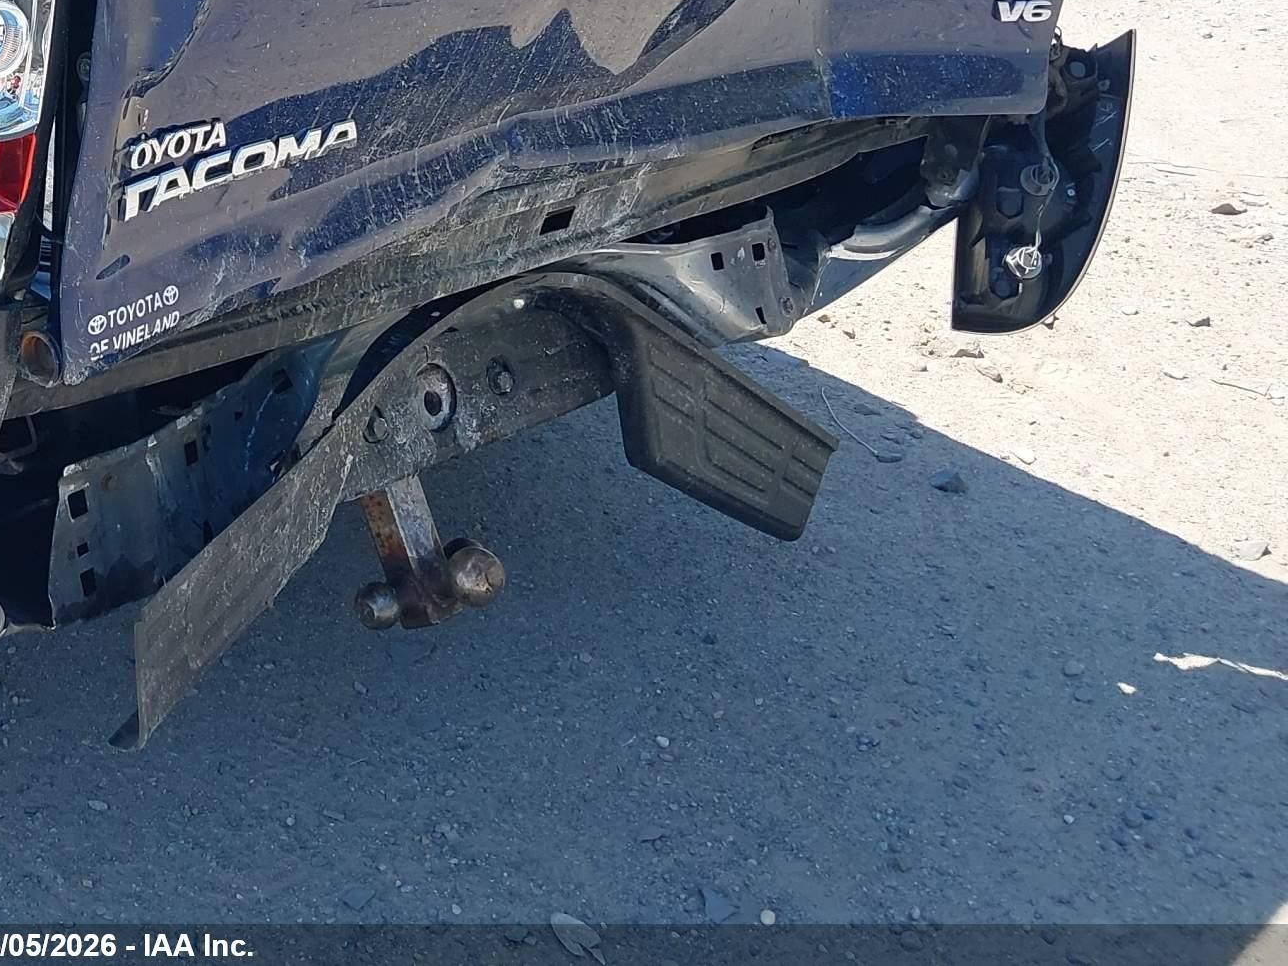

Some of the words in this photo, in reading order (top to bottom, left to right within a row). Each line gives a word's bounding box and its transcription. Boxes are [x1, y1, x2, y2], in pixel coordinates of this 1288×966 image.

[997, 0, 1053, 22] V6
[129, 121, 227, 170] OYOTA
[123, 119, 358, 222] TACOMA
[107, 292, 164, 328] TOYOTA
[89, 338, 110, 360] OF
[112, 311, 180, 350] VINELAND
